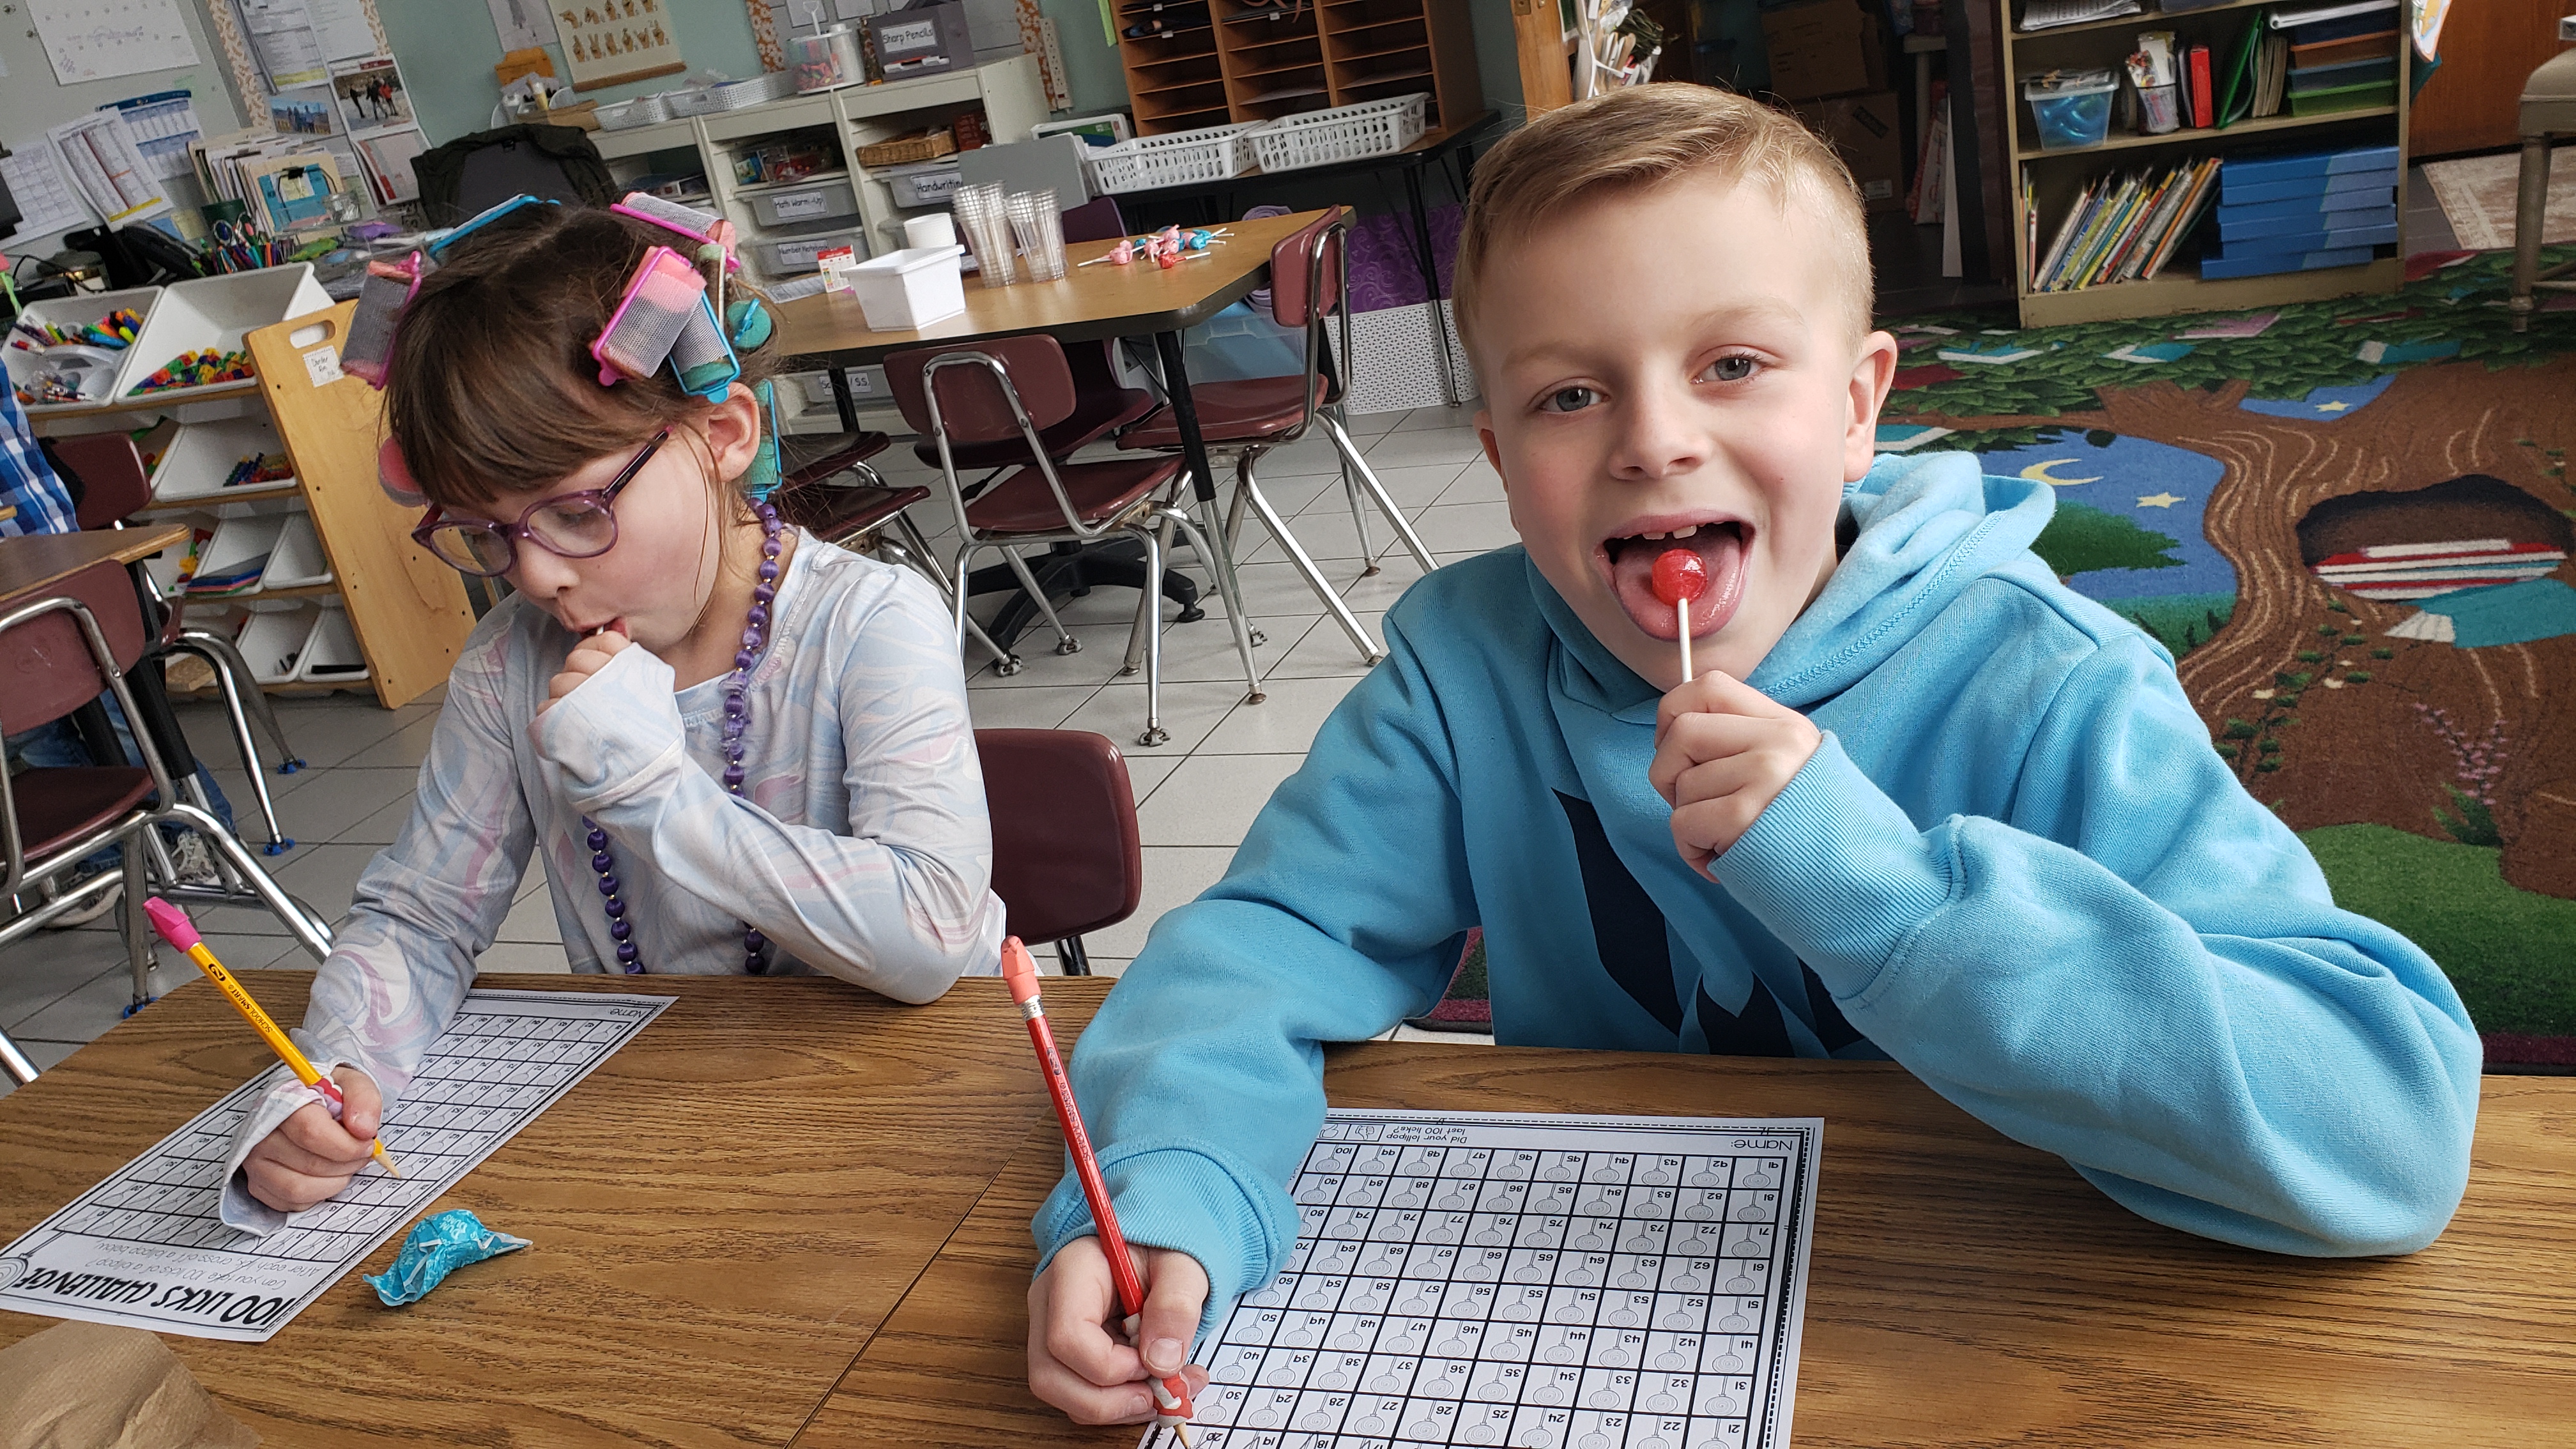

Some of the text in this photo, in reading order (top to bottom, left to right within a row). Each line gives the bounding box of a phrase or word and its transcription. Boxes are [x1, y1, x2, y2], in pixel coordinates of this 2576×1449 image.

[1386, 1133, 1420, 1142] lollipop
[1730, 1139, 1793, 1151] Name:
[1450, 1215, 1464, 1223] 77
[1548, 1219, 1563, 1227] 75
[1598, 1222, 1614, 1230] 74
[1650, 1224, 1664, 1232] 73
[1701, 1226, 1717, 1234] 72
[1759, 1227, 1769, 1236] 71
[1341, 1245, 1356, 1253] 69
[1487, 1252, 1503, 1260] 66
[1537, 1254, 1553, 1262] 65
[1589, 1256, 1605, 1264] 64
[1641, 1259, 1657, 1268] 63
[1694, 1261, 1710, 1270] 62
[1752, 1263, 1765, 1271] 61
[1278, 1277, 1293, 1285] 60
[1326, 1280, 1342, 1288] 59
[1376, 1282, 1391, 1291] 58
[1475, 1287, 1491, 1296] 56
[1526, 1290, 1543, 1299] 55
[12, 1268, 297, 1326] 100 LICKS CHALLENGE
[1580, 1292, 1596, 1301] 54
[1634, 1295, 1650, 1304] 53
[1687, 1298, 1704, 1307] 52
[1747, 1300, 1759, 1309] 51
[1261, 1314, 1277, 1322] 50
[1308, 1316, 1326, 1325] 49
[1360, 1319, 1376, 1328] 48
[1410, 1322, 1427, 1331] 47
[1462, 1326, 1479, 1334] 46
[1515, 1328, 1533, 1337] 45
[1569, 1331, 1586, 1340] 44
[1624, 1335, 1641, 1344] 43
[1678, 1338, 1696, 1347] 42
[1740, 1340, 1753, 1349] 41
[1243, 1351, 1260, 1360] 40
[1294, 1354, 1310, 1363] 39
[1345, 1358, 1361, 1367] 38
[1397, 1361, 1413, 1370] 37
[1450, 1365, 1466, 1374] 36
[1504, 1368, 1521, 1377] 35
[1560, 1372, 1576, 1381] 34
[1615, 1375, 1632, 1384] 33
[1671, 1379, 1689, 1388] 32
[1735, 1381, 1747, 1390] 31
[1225, 1391, 1242, 1400] 30
[1276, 1395, 1293, 1404] 29
[1329, 1397, 1346, 1407] 28
[1381, 1401, 1399, 1411] 27
[1436, 1406, 1453, 1415] 26
[1491, 1409, 1510, 1419] 25
[1548, 1413, 1566, 1423] 24
[1606, 1417, 1623, 1427] 23
[1662, 1421, 1681, 1431] 22
[1728, 1424, 1740, 1434] 21
[1262, 1436, 1276, 1446] 19
